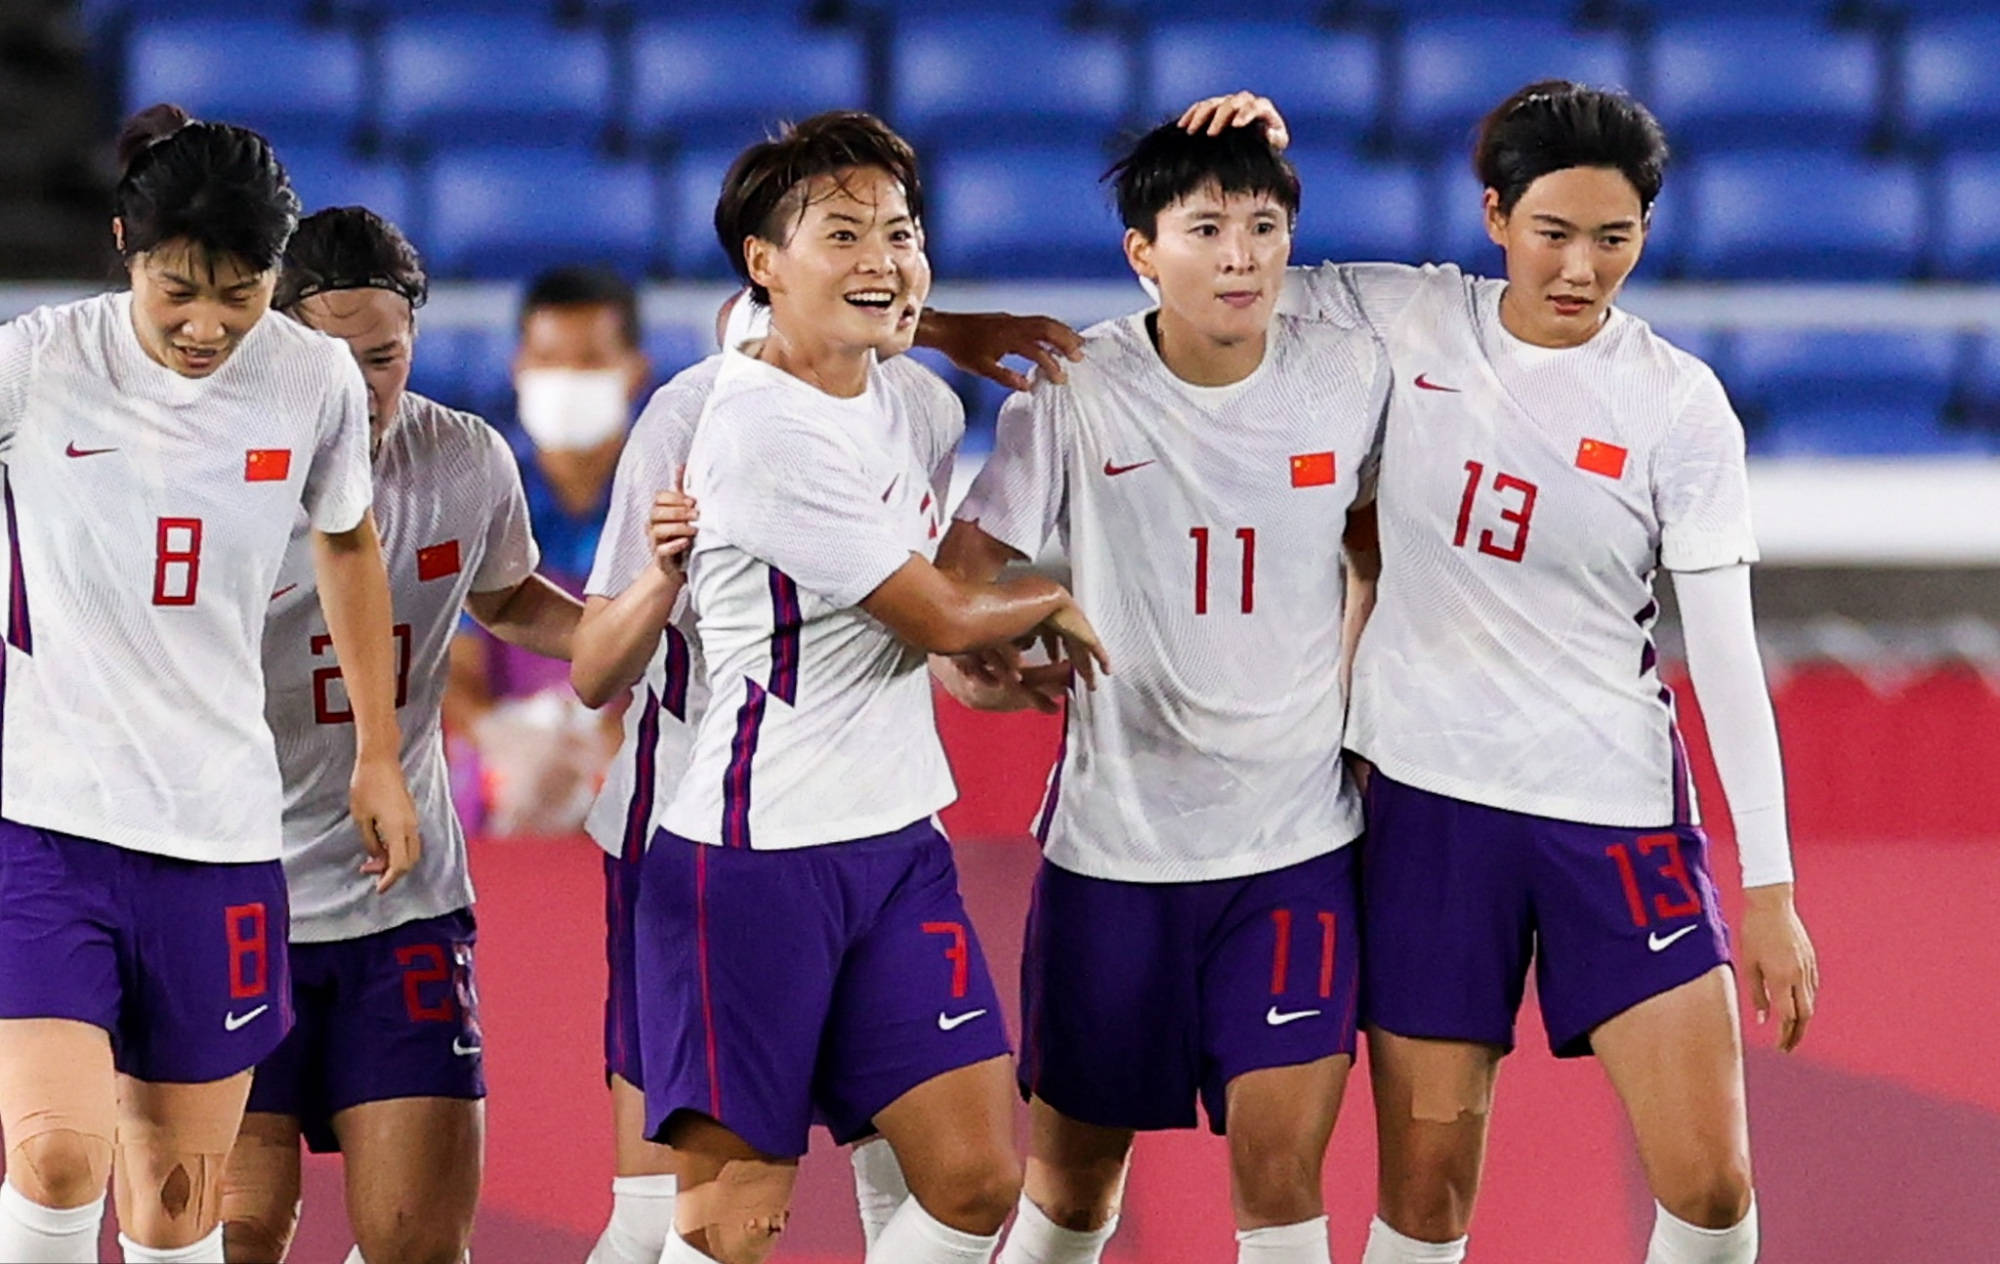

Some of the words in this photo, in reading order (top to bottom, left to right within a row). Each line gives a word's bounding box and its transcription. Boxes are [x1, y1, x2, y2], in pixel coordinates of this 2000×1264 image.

[1453, 460, 1538, 563] 13
[152, 517, 203, 606] 8
[1189, 527, 1255, 615] 11
[310, 623, 411, 724] 2
[1606, 834, 1702, 927] 13
[225, 903, 268, 998] 8
[921, 922, 968, 998] 7
[1271, 909, 1337, 998] 11
